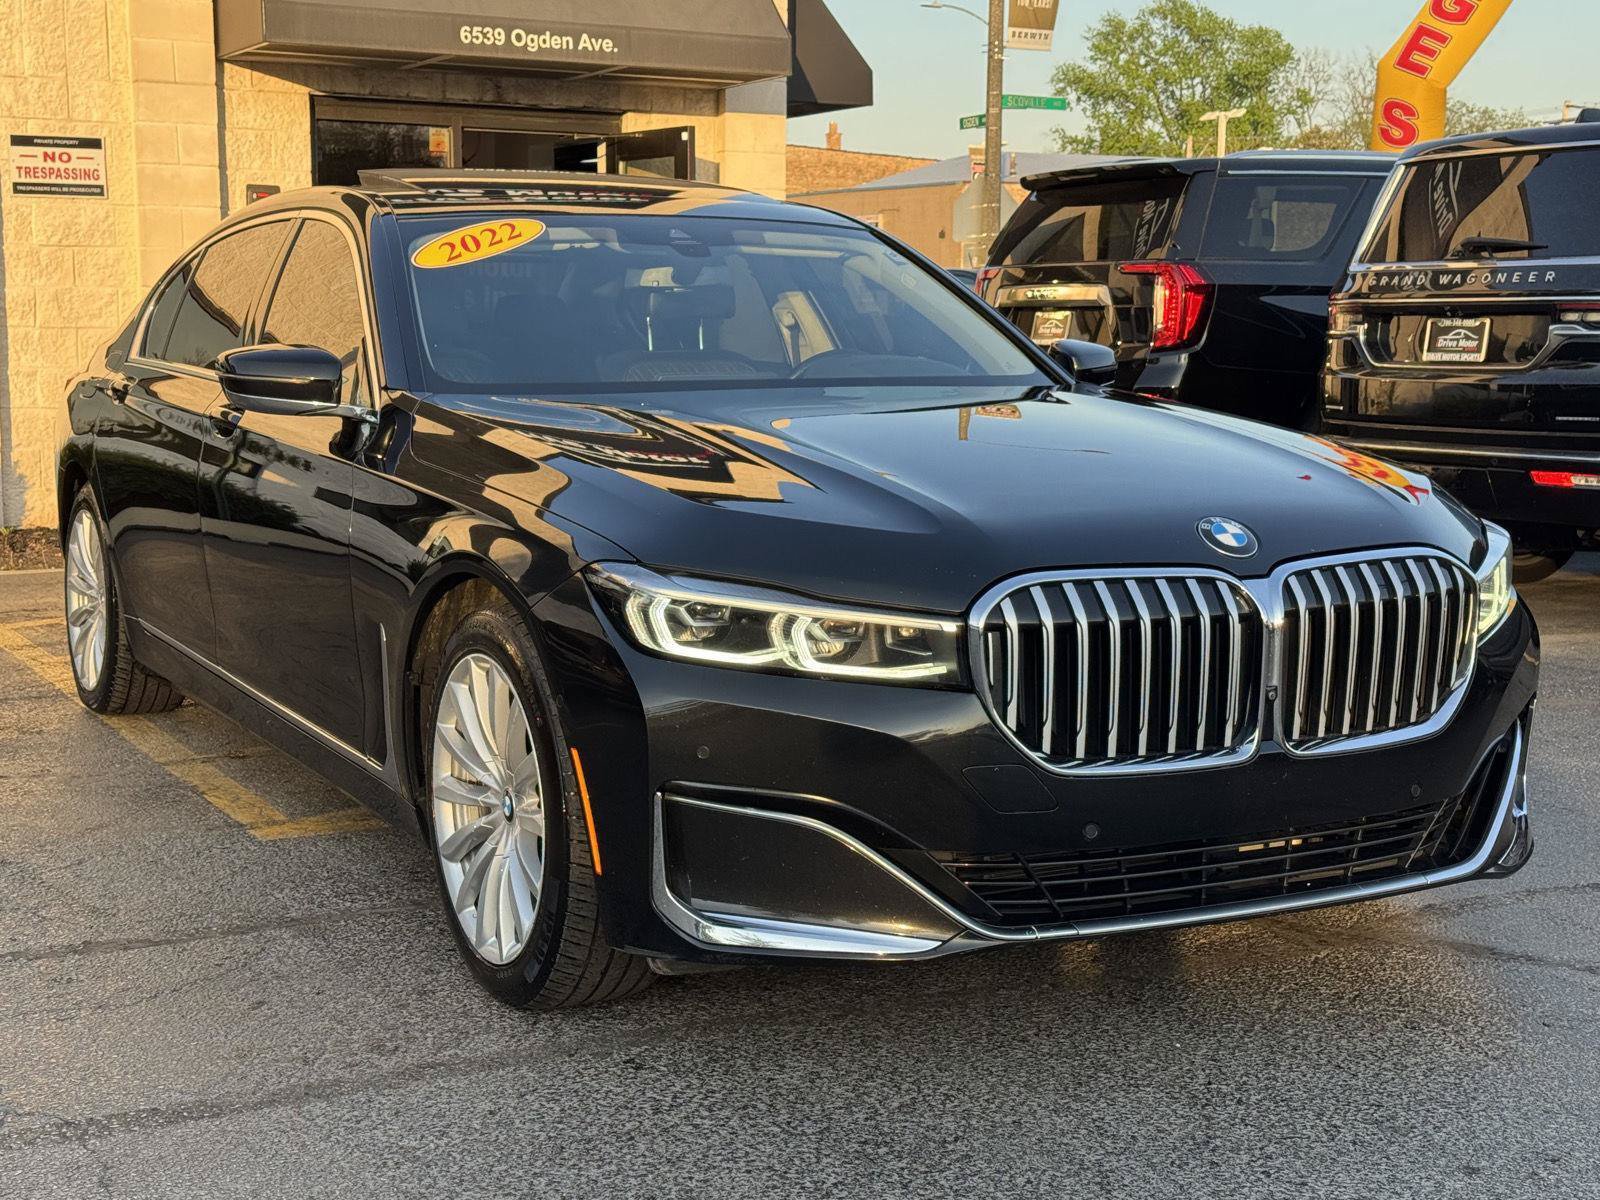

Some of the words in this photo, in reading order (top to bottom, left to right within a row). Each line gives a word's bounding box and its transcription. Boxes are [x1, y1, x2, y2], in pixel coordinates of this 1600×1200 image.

[459, 25, 506, 45] 6539
[510, 28, 574, 52] Ogden
[577, 33, 619, 53] Ave.
[42, 151, 72, 164] NO
[15, 166, 101, 181] TRESPASSING
[438, 222, 523, 263] 2022
[1369, 272, 1427, 286] GRAND
[1438, 270, 1556, 285] WAGONEER
